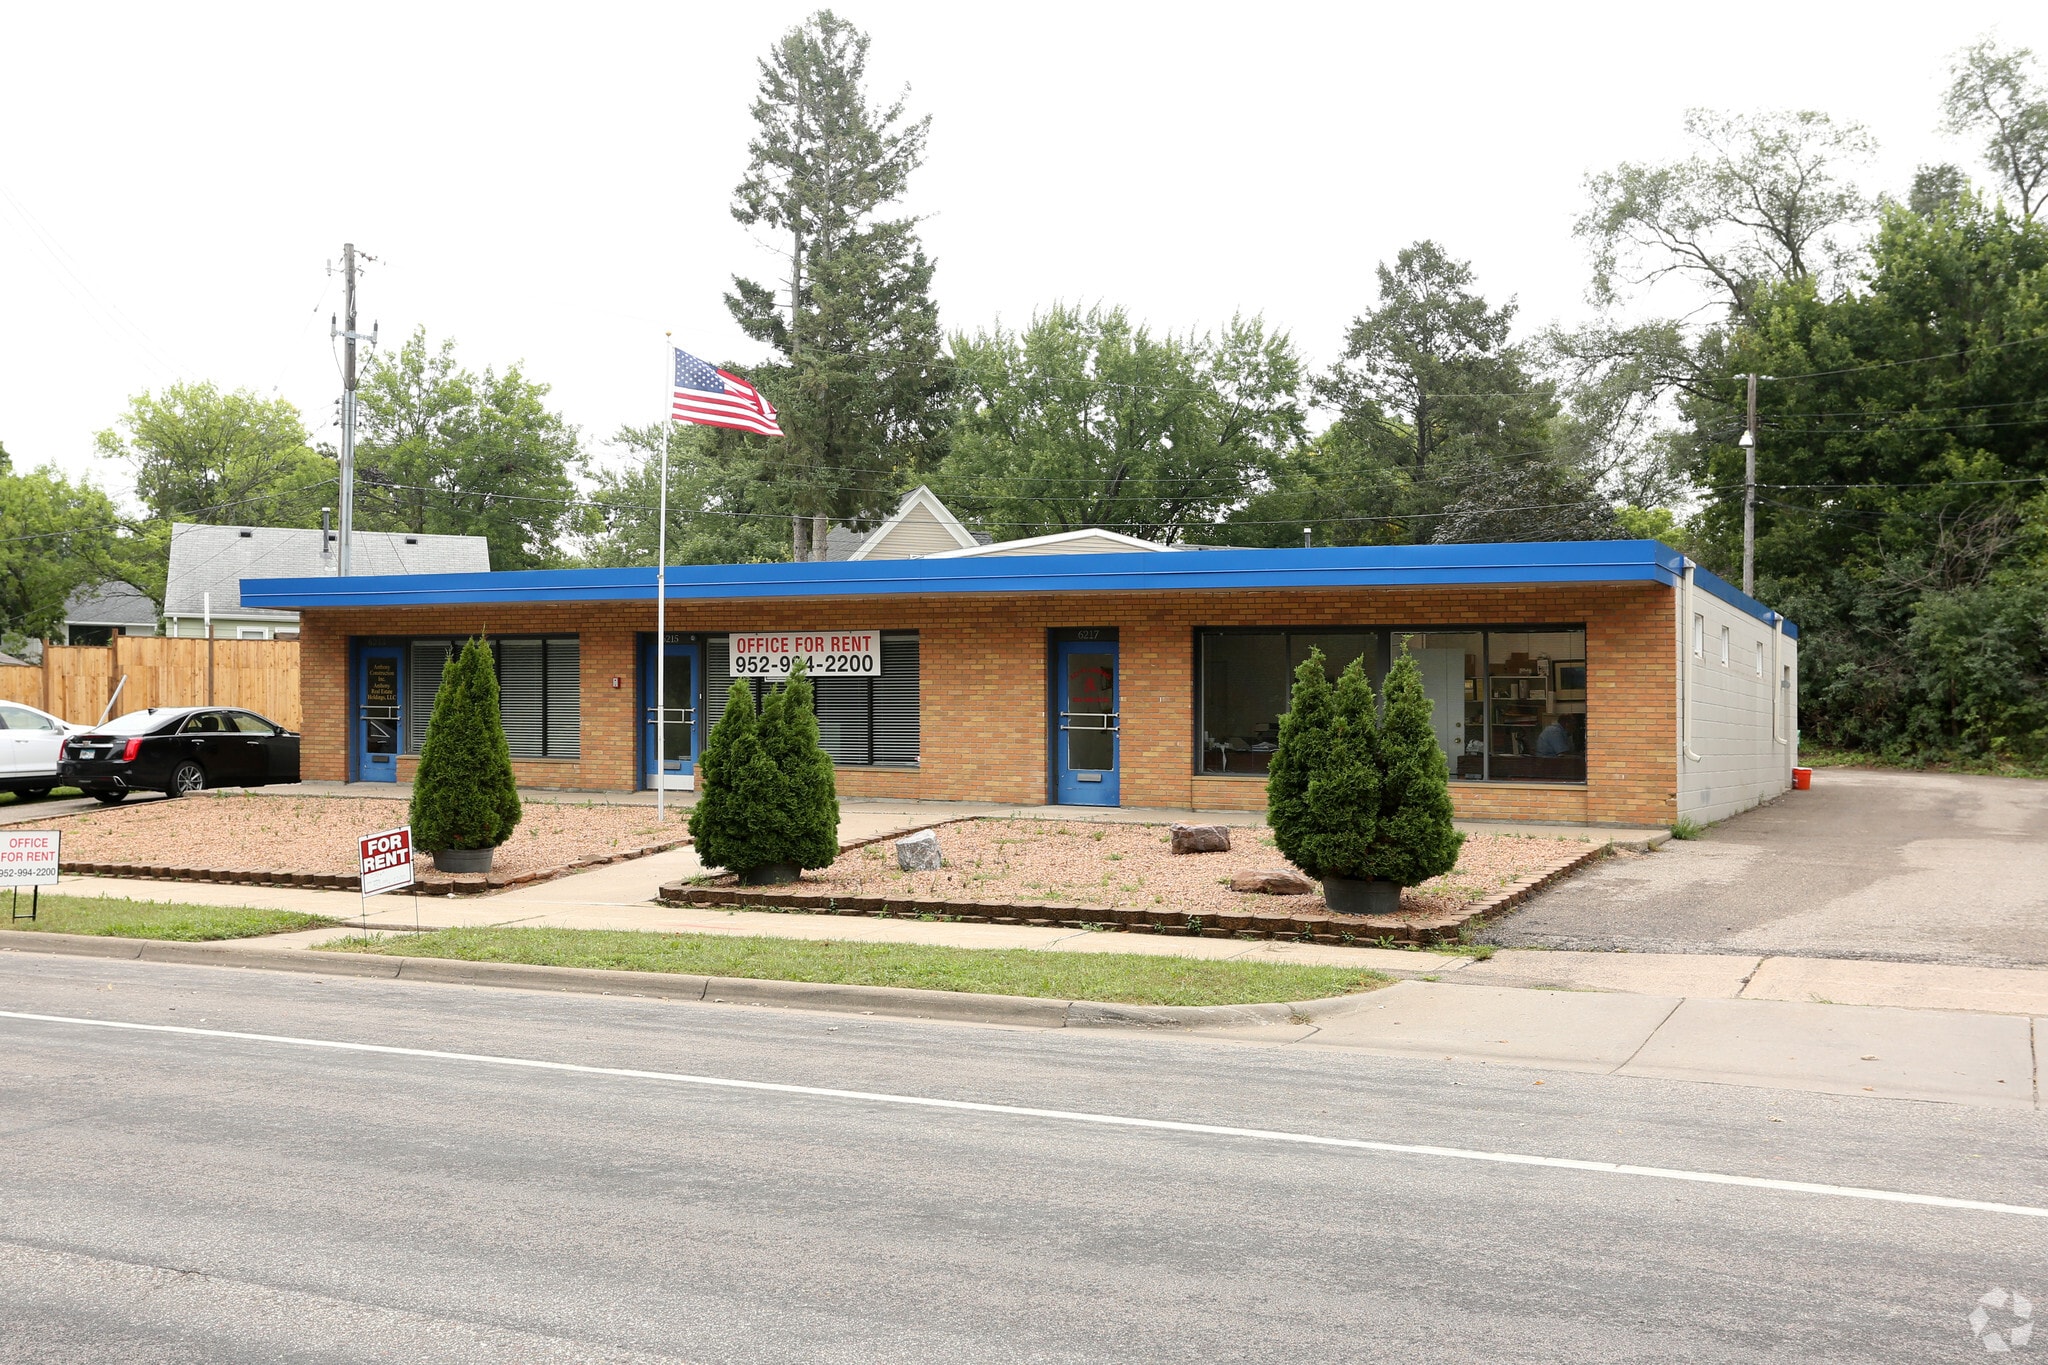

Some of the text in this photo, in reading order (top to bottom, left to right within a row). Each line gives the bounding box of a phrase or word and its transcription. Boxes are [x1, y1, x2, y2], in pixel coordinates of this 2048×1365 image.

[664, 634, 679, 643] 215
[1077, 630, 1100, 640] 6217
[736, 635, 872, 653] OFFICE FOR RENT
[9, 837, 49, 848] OFFICE
[367, 834, 403, 856] FOR
[1, 851, 56, 862] FOR RENT
[363, 848, 409, 873] RENT
